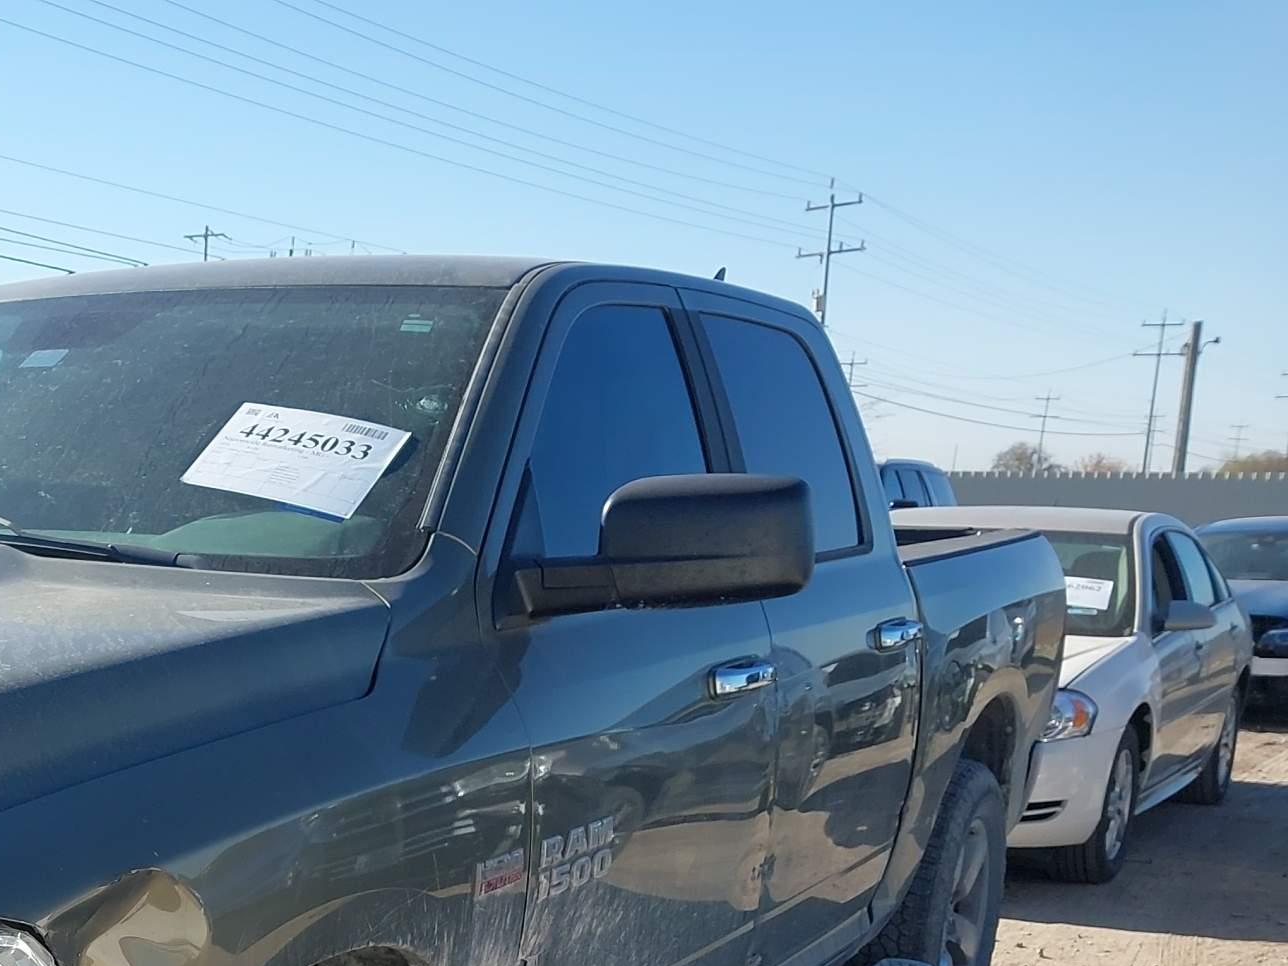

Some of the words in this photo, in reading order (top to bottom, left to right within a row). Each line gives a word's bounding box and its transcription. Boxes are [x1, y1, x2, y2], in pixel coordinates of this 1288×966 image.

[239, 422, 374, 461] 44245033
[541, 816, 616, 868] RAM
[538, 849, 613, 903] 1500
